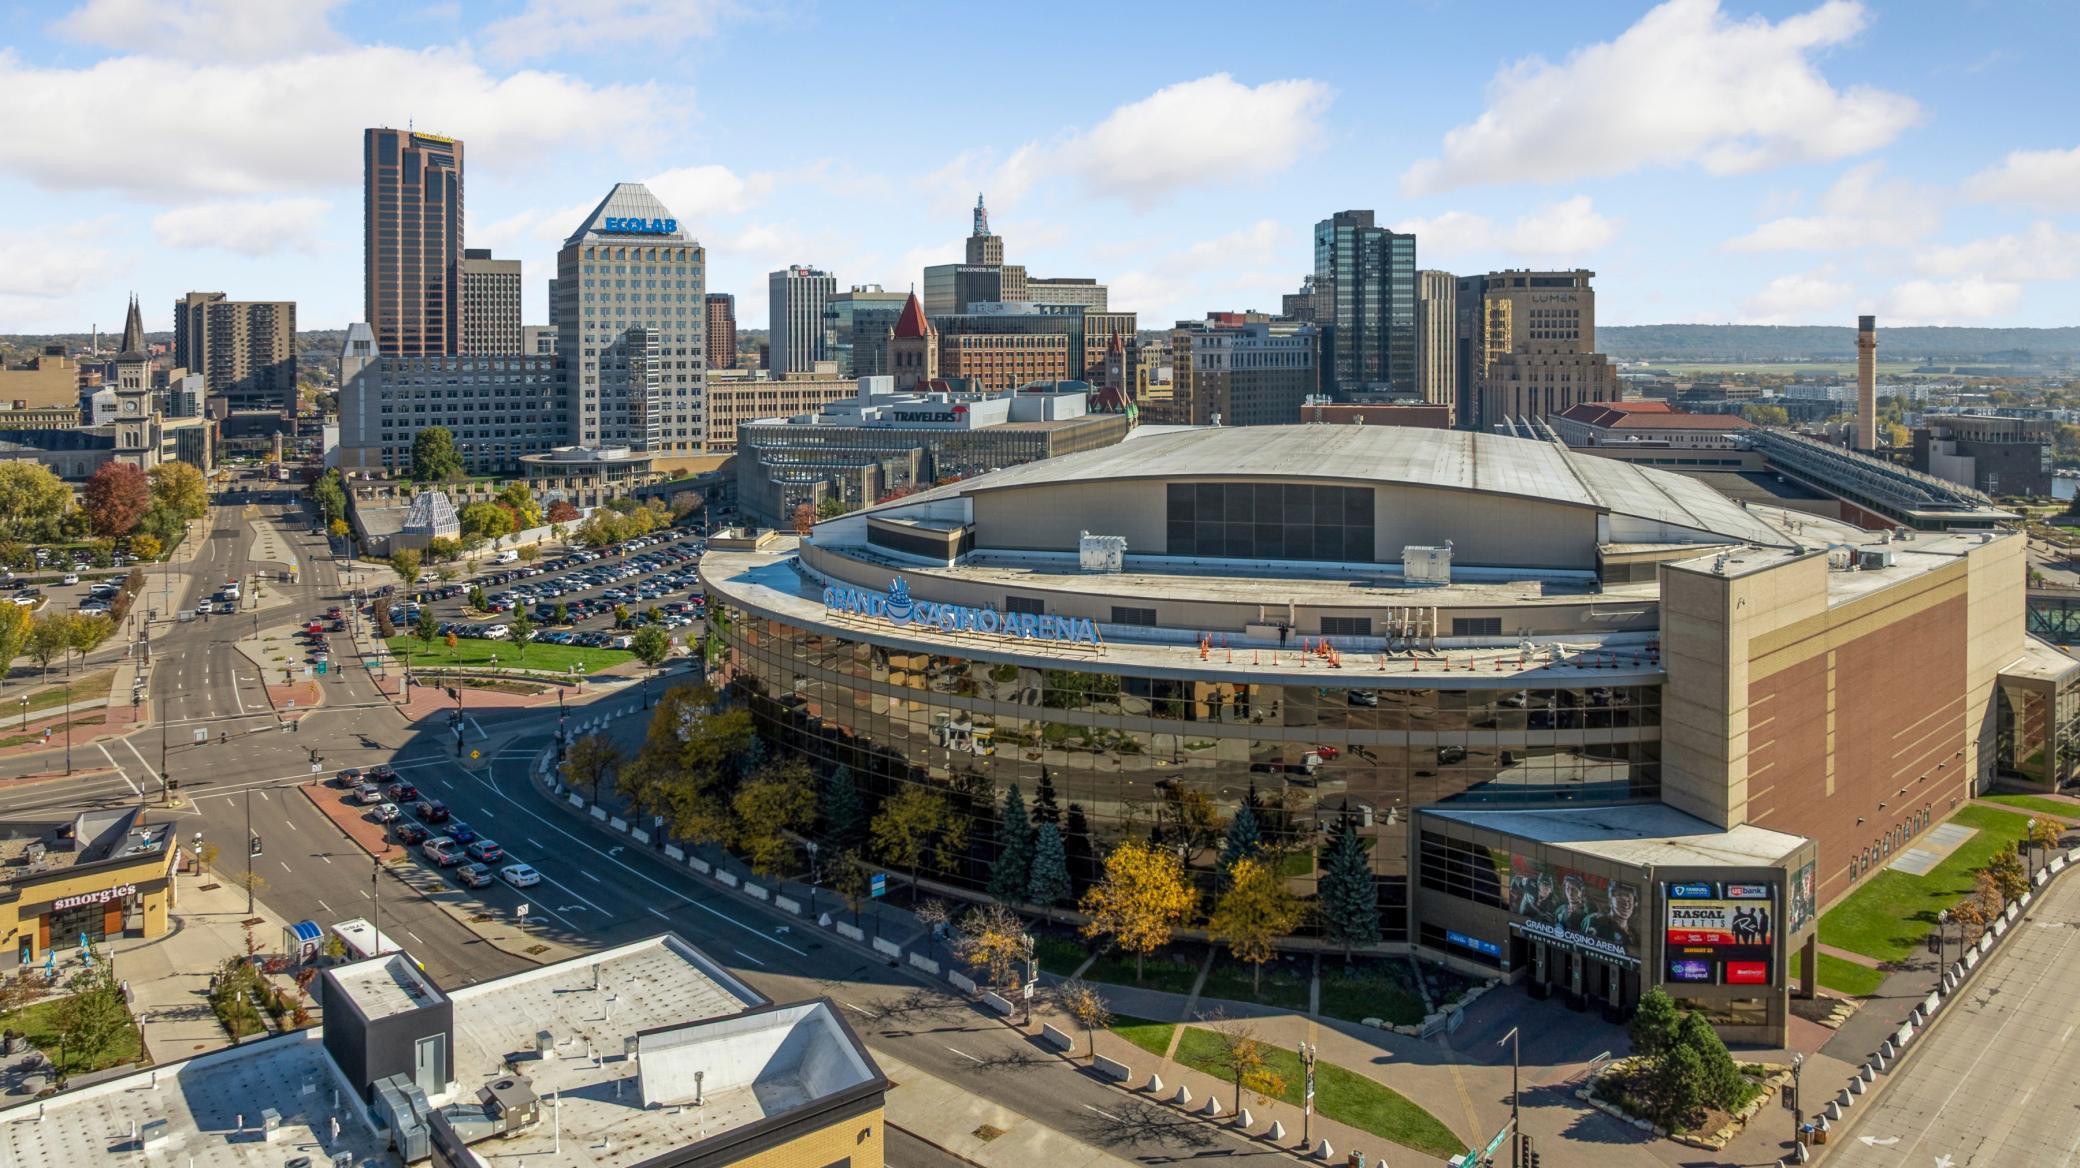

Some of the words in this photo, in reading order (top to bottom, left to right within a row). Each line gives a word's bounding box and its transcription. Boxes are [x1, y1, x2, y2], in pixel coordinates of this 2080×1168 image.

[605, 217, 677, 233] ECOLAB
[1532, 295, 1577, 303] LUMEN
[894, 411, 956, 422] TRAVELERS
[823, 586, 886, 617] GRAND
[913, 601, 1000, 634] CASINO
[1002, 611, 1099, 645] ARENA
[54, 883, 137, 910] smorgie's
[1672, 910, 1725, 919] RASCAL
[1672, 919, 1725, 928] FLATTS
[1525, 919, 1554, 934] GRAND
[1564, 930, 1595, 946] CASINO
[1595, 940, 1626, 956] ARENA
